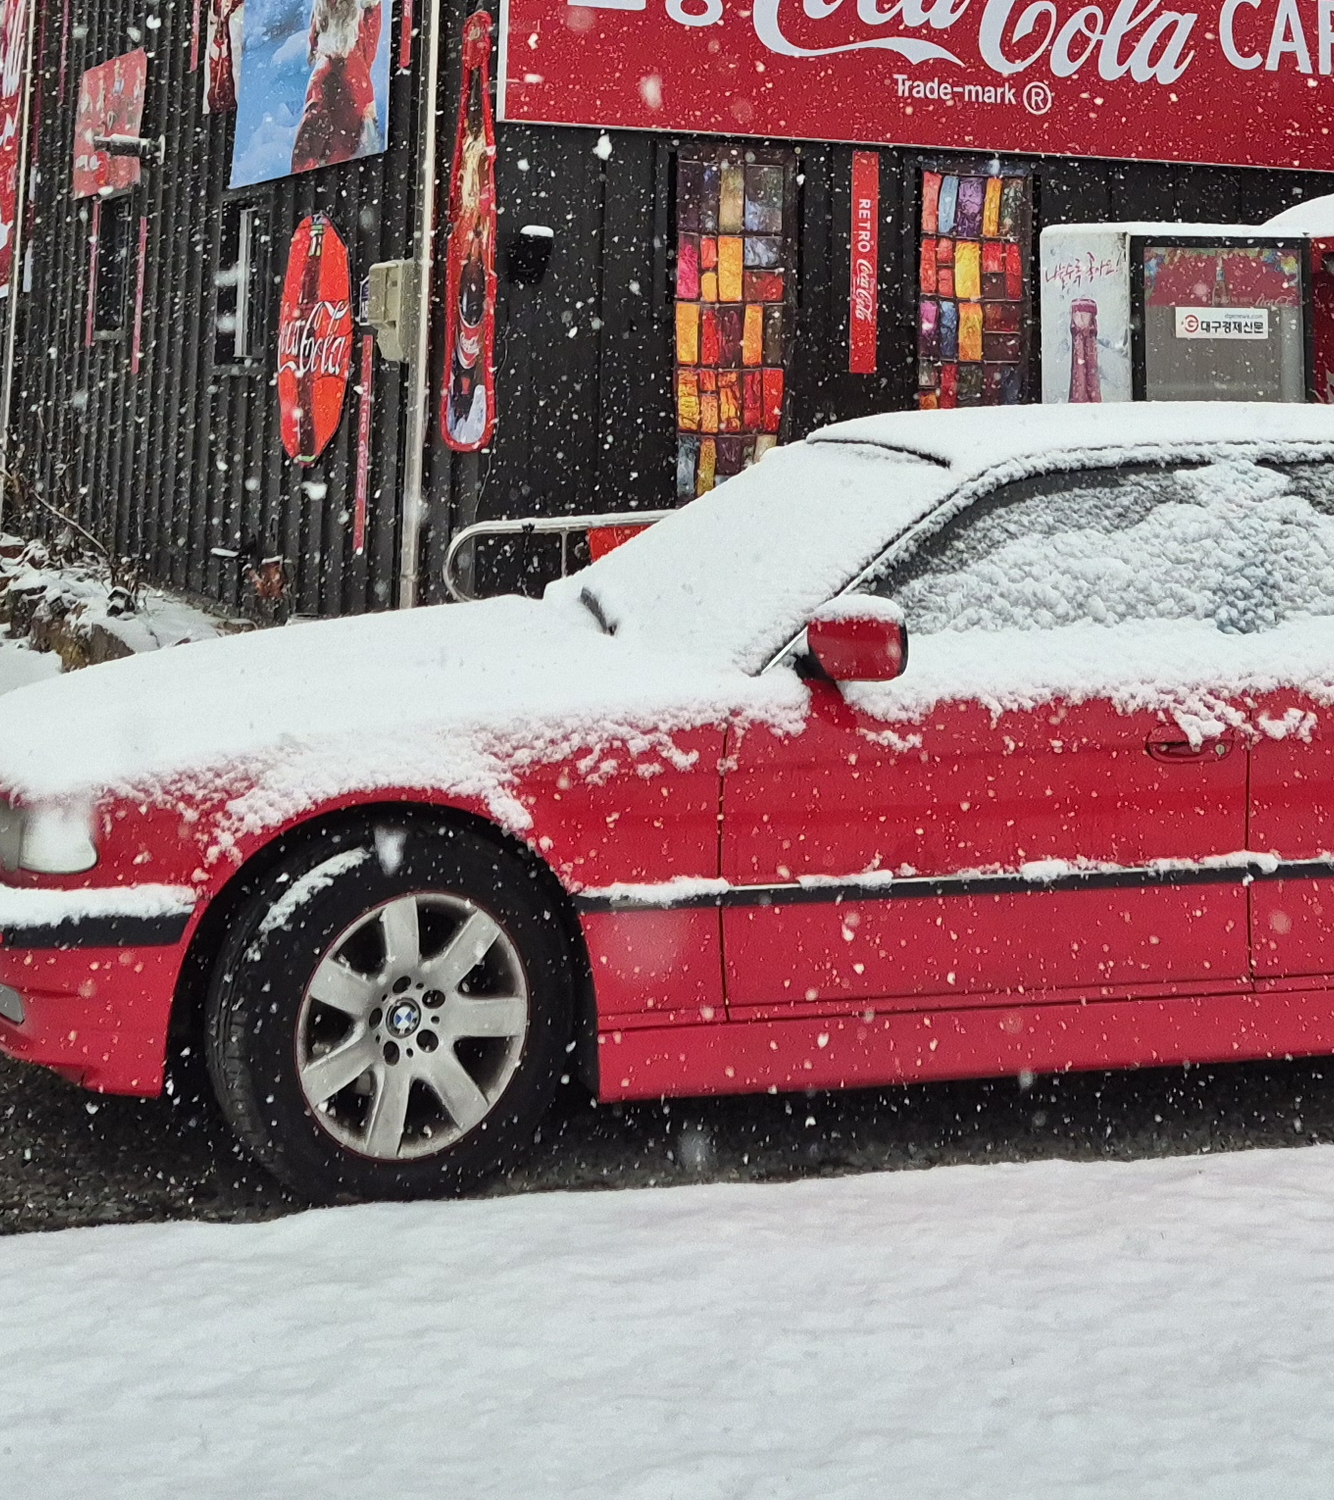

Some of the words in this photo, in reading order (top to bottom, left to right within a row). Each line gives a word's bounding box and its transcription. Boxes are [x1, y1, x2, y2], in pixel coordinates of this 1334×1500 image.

[893, 74, 1016, 105] Trade-mark
[858, 199, 871, 253] RETRO
[855, 259, 873, 323] Coca-Cola
[1200, 320, 1264, 334] 대구경제신문
